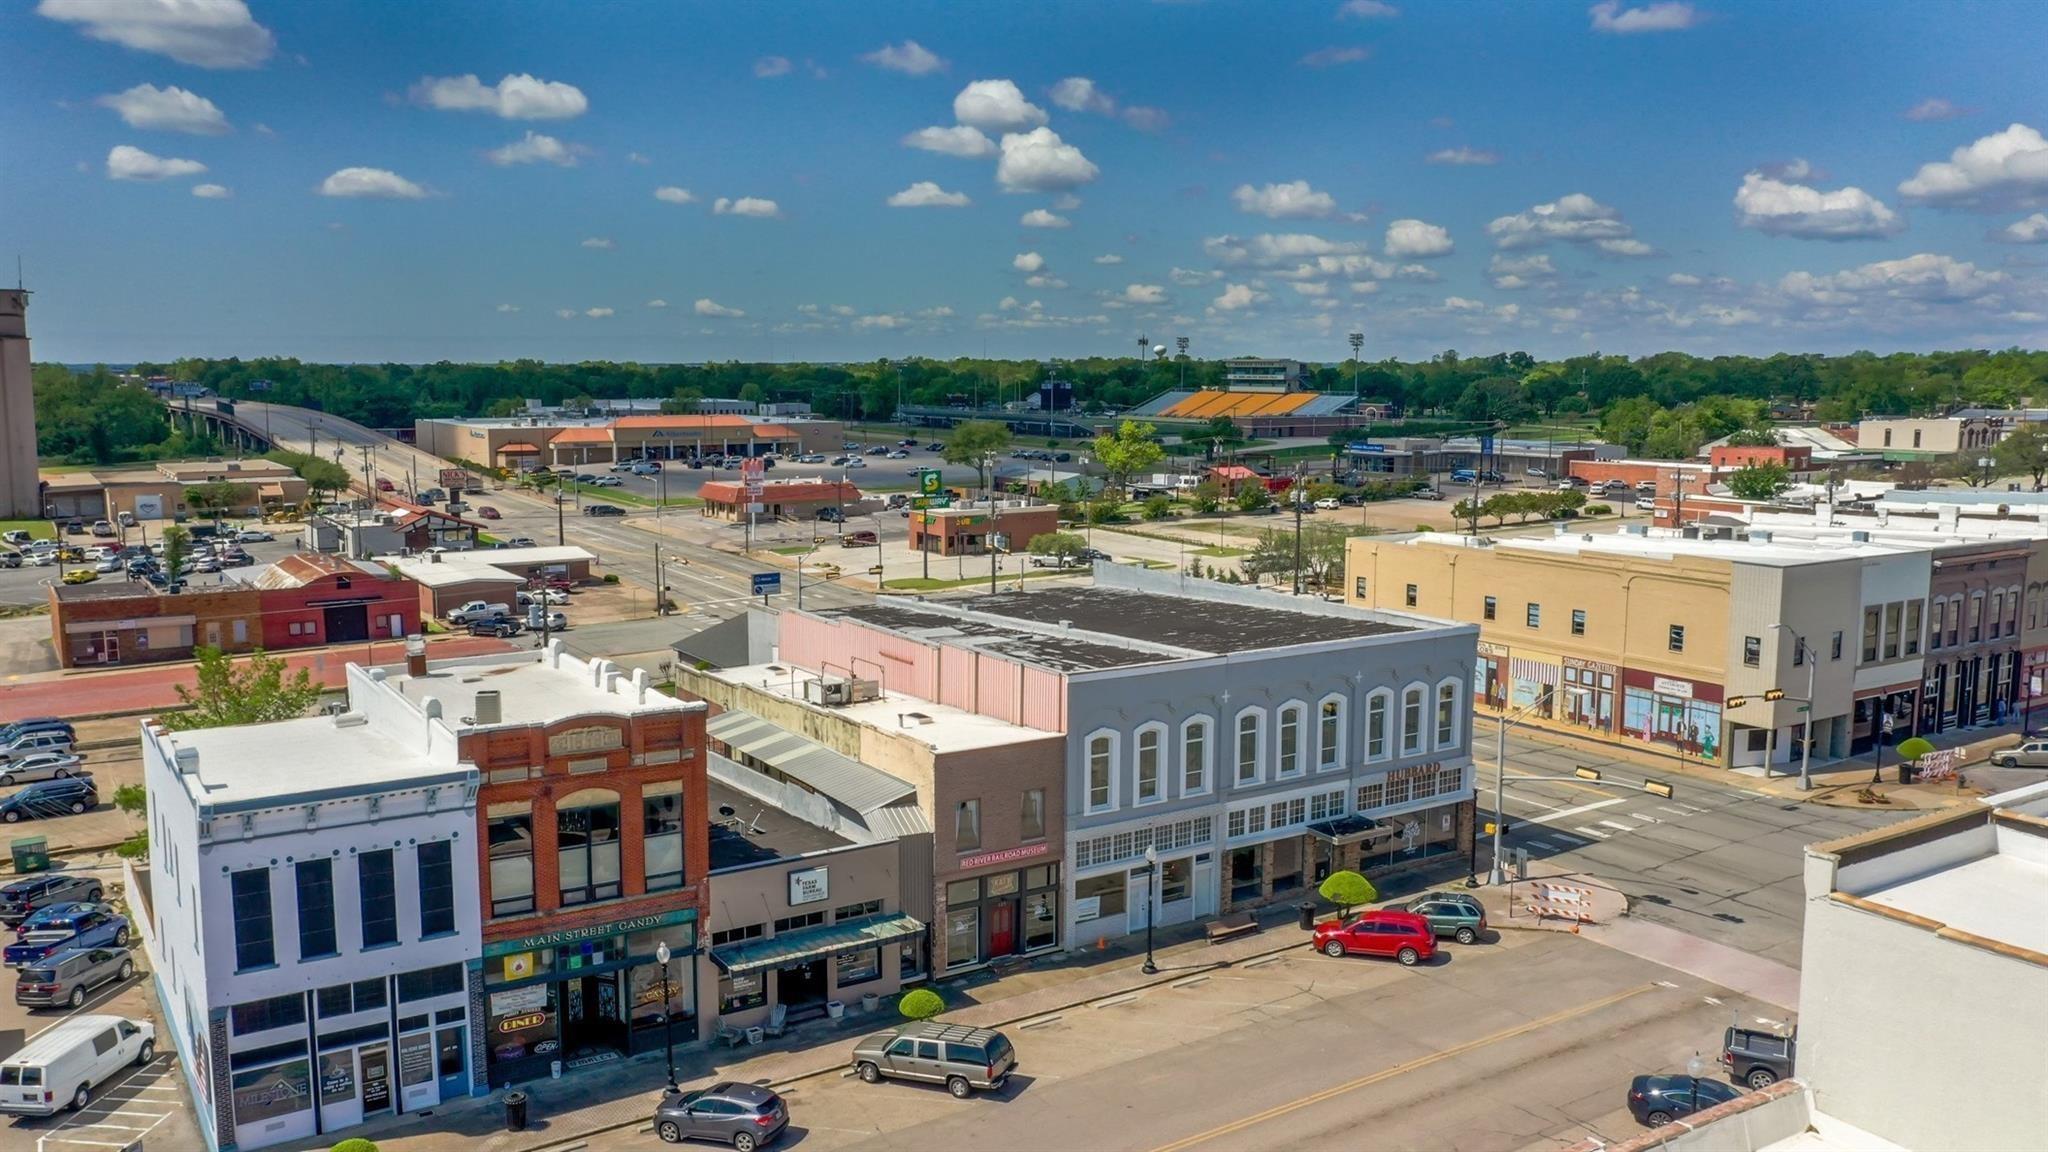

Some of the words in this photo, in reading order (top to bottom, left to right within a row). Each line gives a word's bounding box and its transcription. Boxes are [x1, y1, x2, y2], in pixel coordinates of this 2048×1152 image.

[1387, 762, 1441, 780] HUBBARD
[961, 859, 974, 867] RED
[974, 857, 991, 866] RIVER
[991, 850, 1020, 862] RAILROAD
[1021, 845, 1047, 856] MUSEUM
[522, 933, 561, 948] MAIN
[565, 924, 613, 941] STREET
[618, 915, 663, 931] CANDY
[503, 1015, 541, 1030] DINER
[535, 1041, 557, 1052] OPEN
